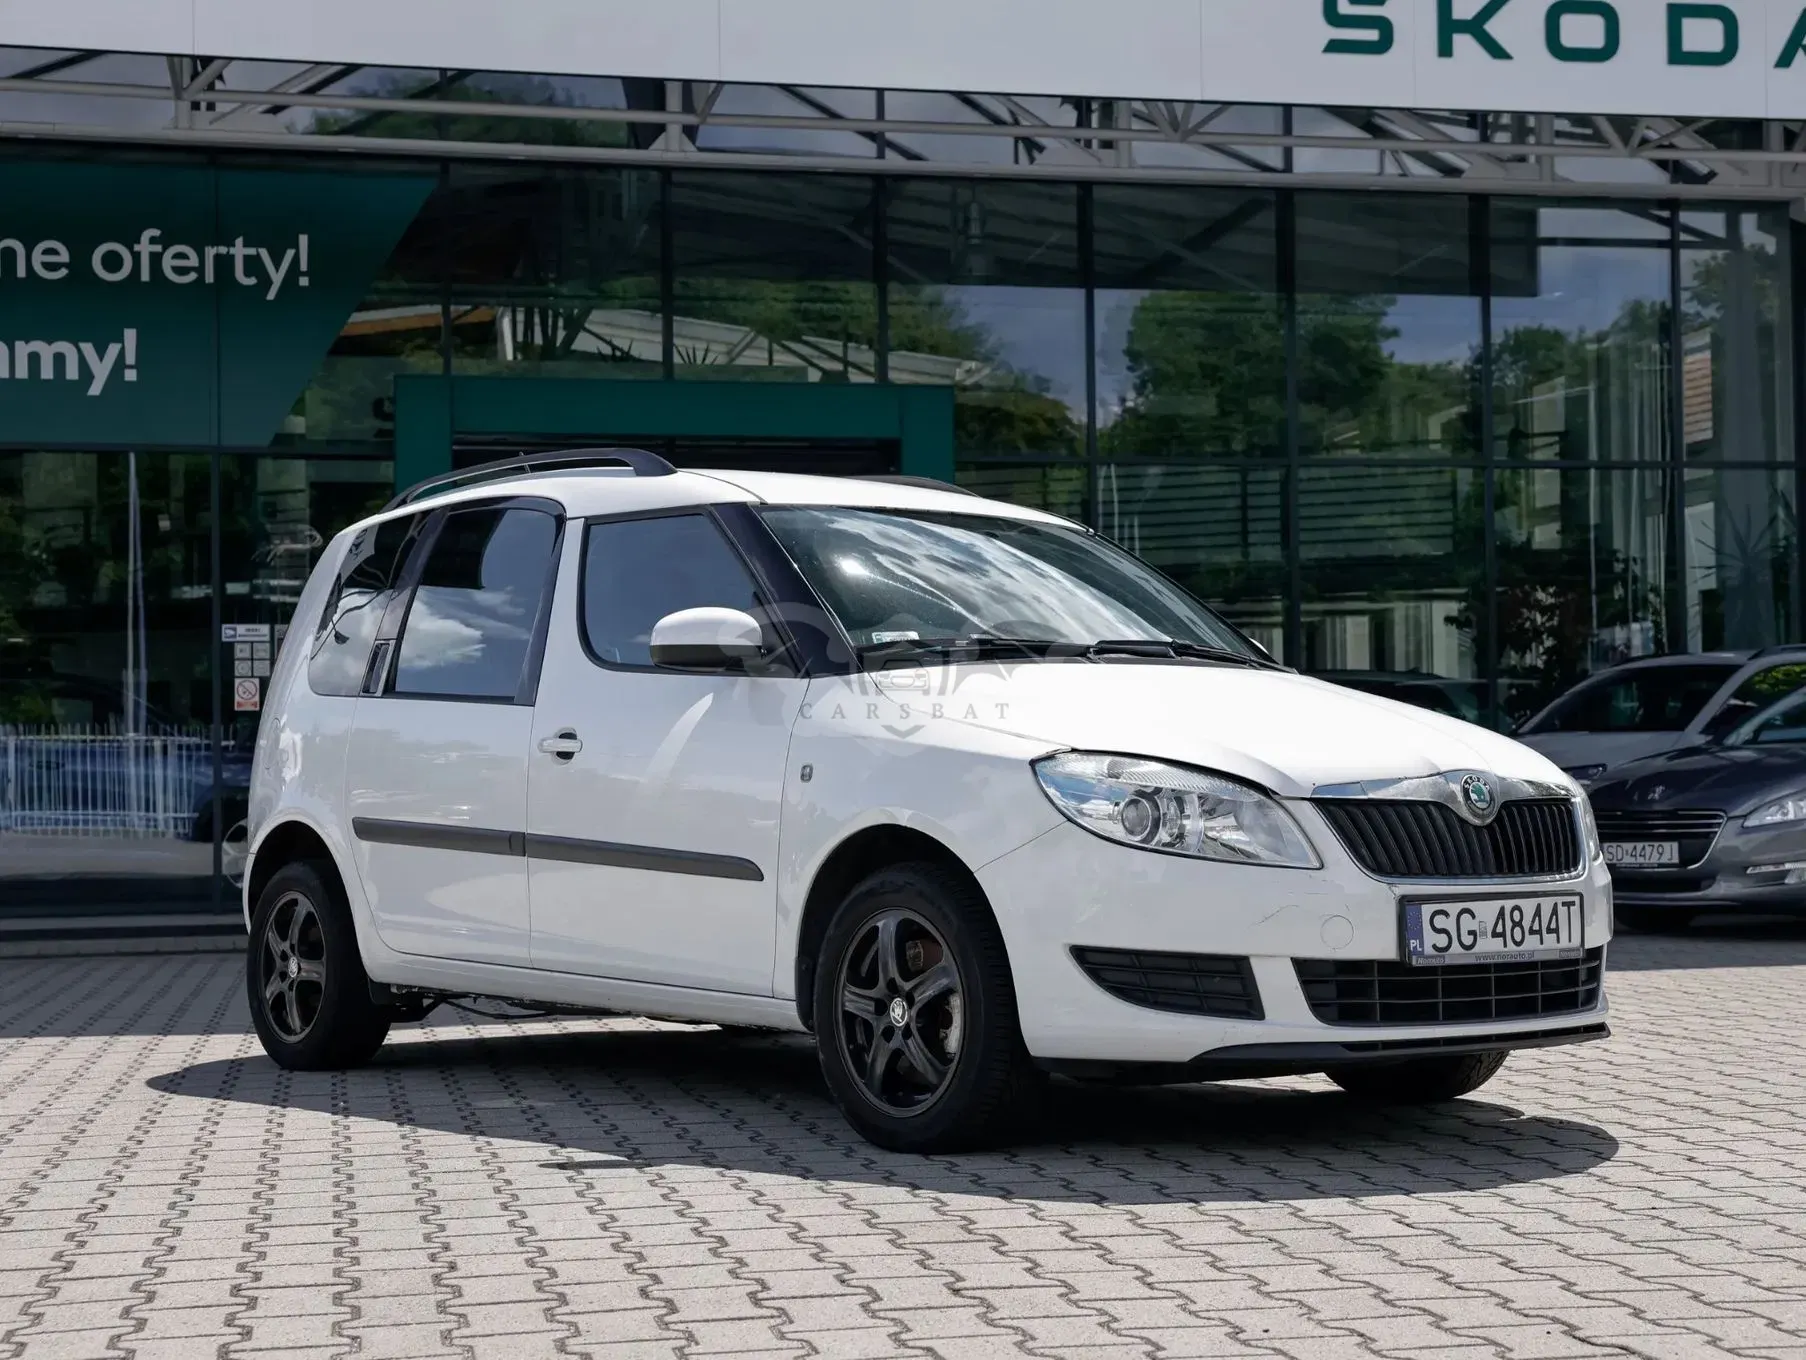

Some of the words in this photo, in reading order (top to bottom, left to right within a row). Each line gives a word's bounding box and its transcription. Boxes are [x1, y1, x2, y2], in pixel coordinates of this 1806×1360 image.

[91, 228, 309, 300] oferty!
[0, 328, 137, 396] my!
[1606, 845, 1624, 862] SD
[1429, 908, 1478, 953] SG
[1491, 901, 1576, 948] 4844T
[1410, 939, 1422, 951] PL
[1475, 951, 1535, 962] www.norauto.pl
